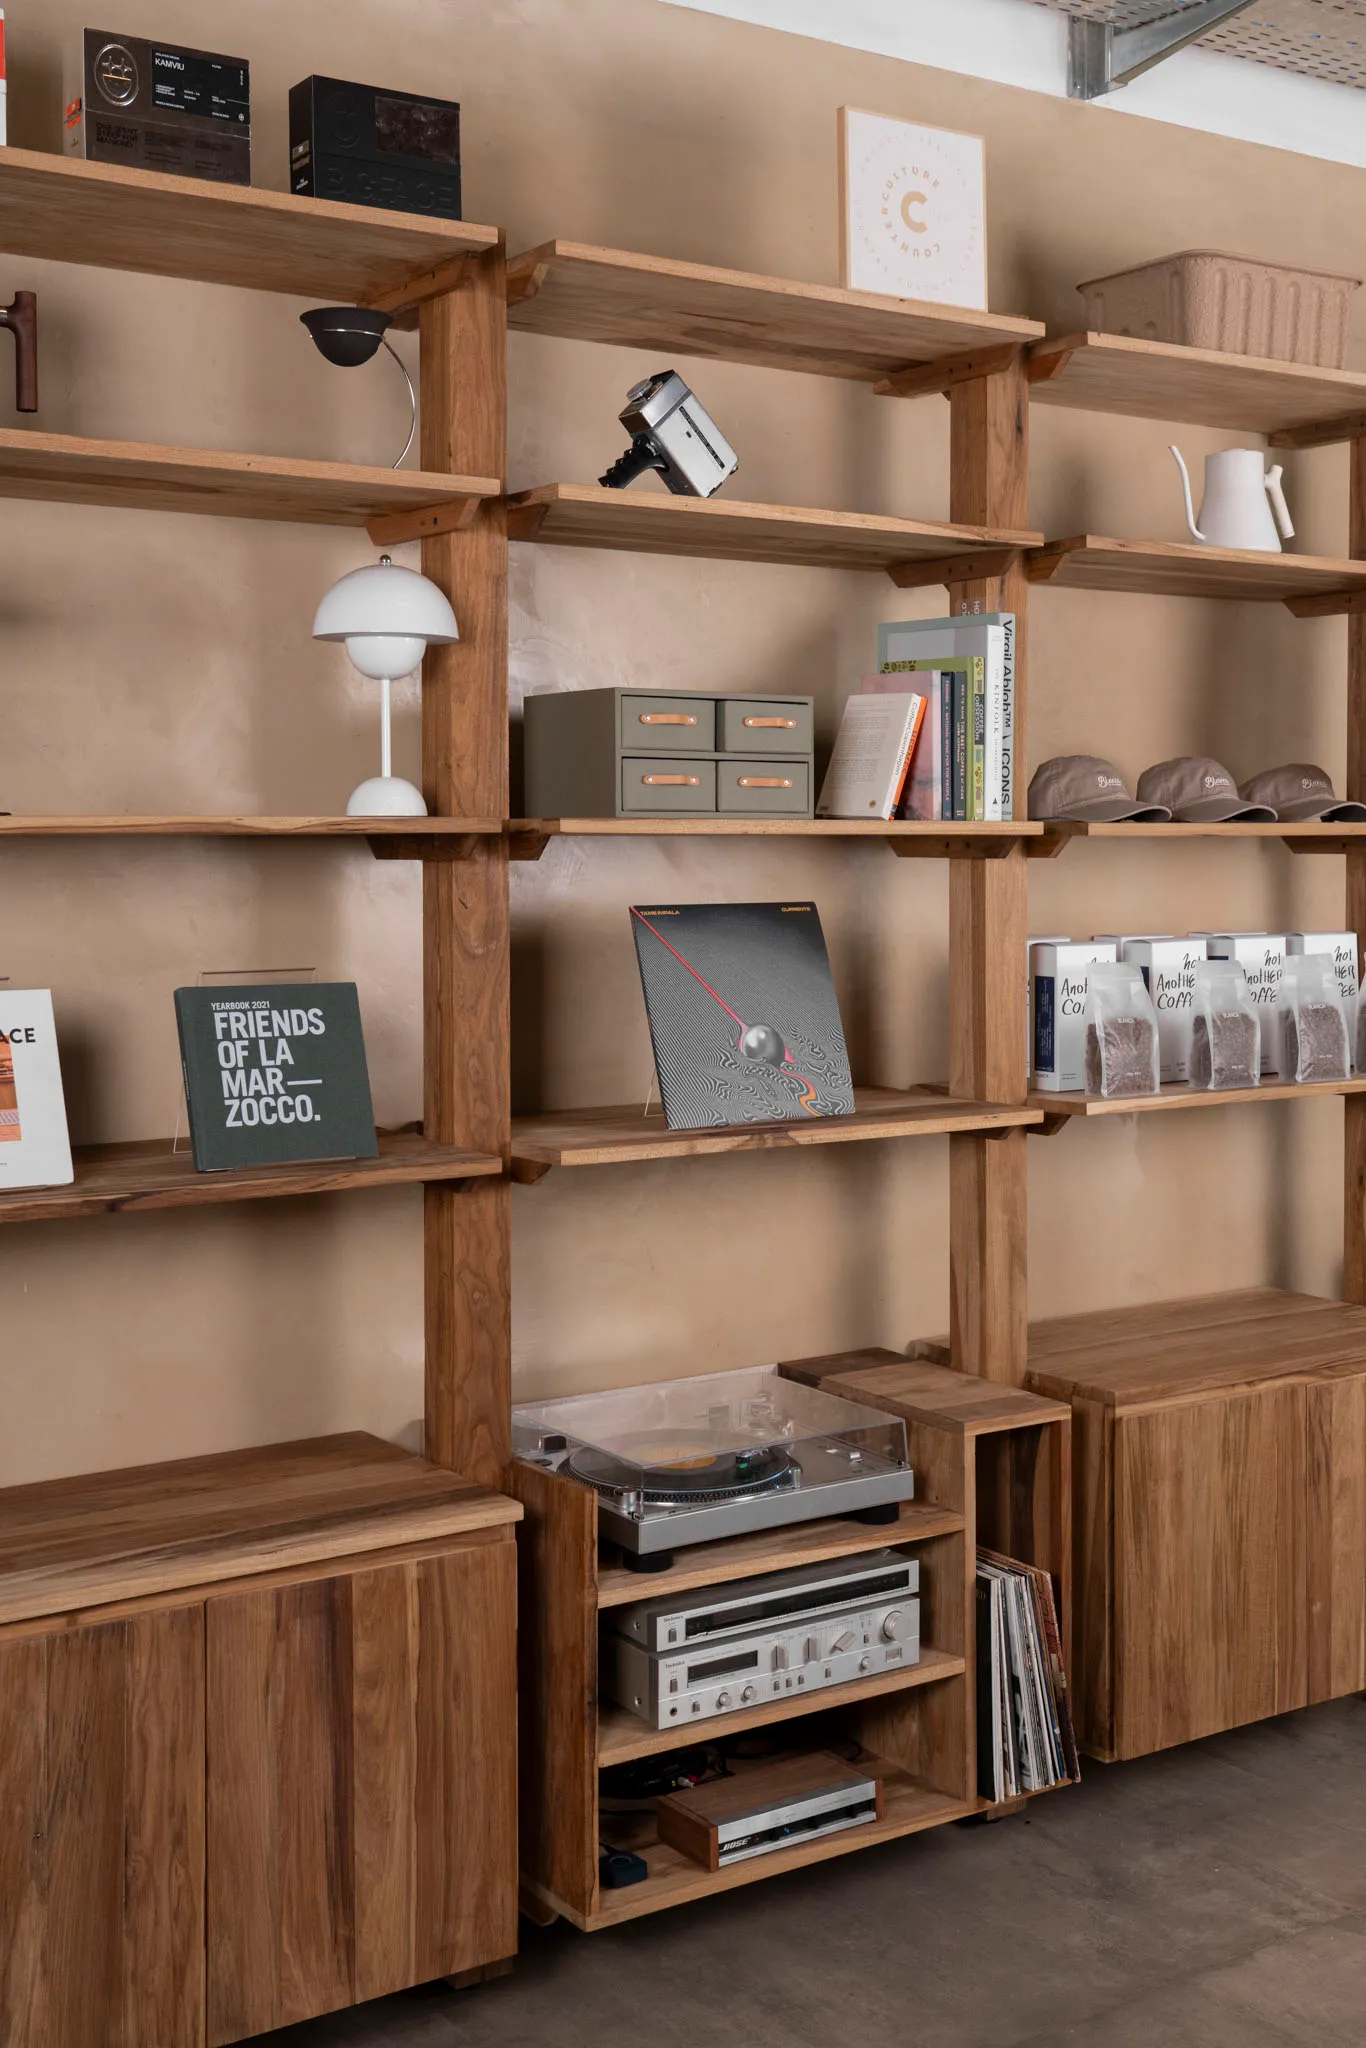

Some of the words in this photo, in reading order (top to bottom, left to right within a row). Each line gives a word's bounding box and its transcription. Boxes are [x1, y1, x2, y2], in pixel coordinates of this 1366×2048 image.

[155, 58, 185, 71] KAMVIU
[901, 190, 928, 234] C
[1001, 748, 1011, 804] ICONS
[1060, 977, 1088, 997] Anot
[1156, 972, 1196, 991] AnotHE
[211, 1001, 250, 1011] YEARBOOK
[251, 1000, 271, 1010] 2021
[213, 1007, 326, 1040] FRIENDS
[217, 1040, 250, 1069] OF
[259, 1039, 295, 1067] LA
[224, 1094, 321, 1128] ZOCCO.
[722, 1838, 749, 1851] BOSE
